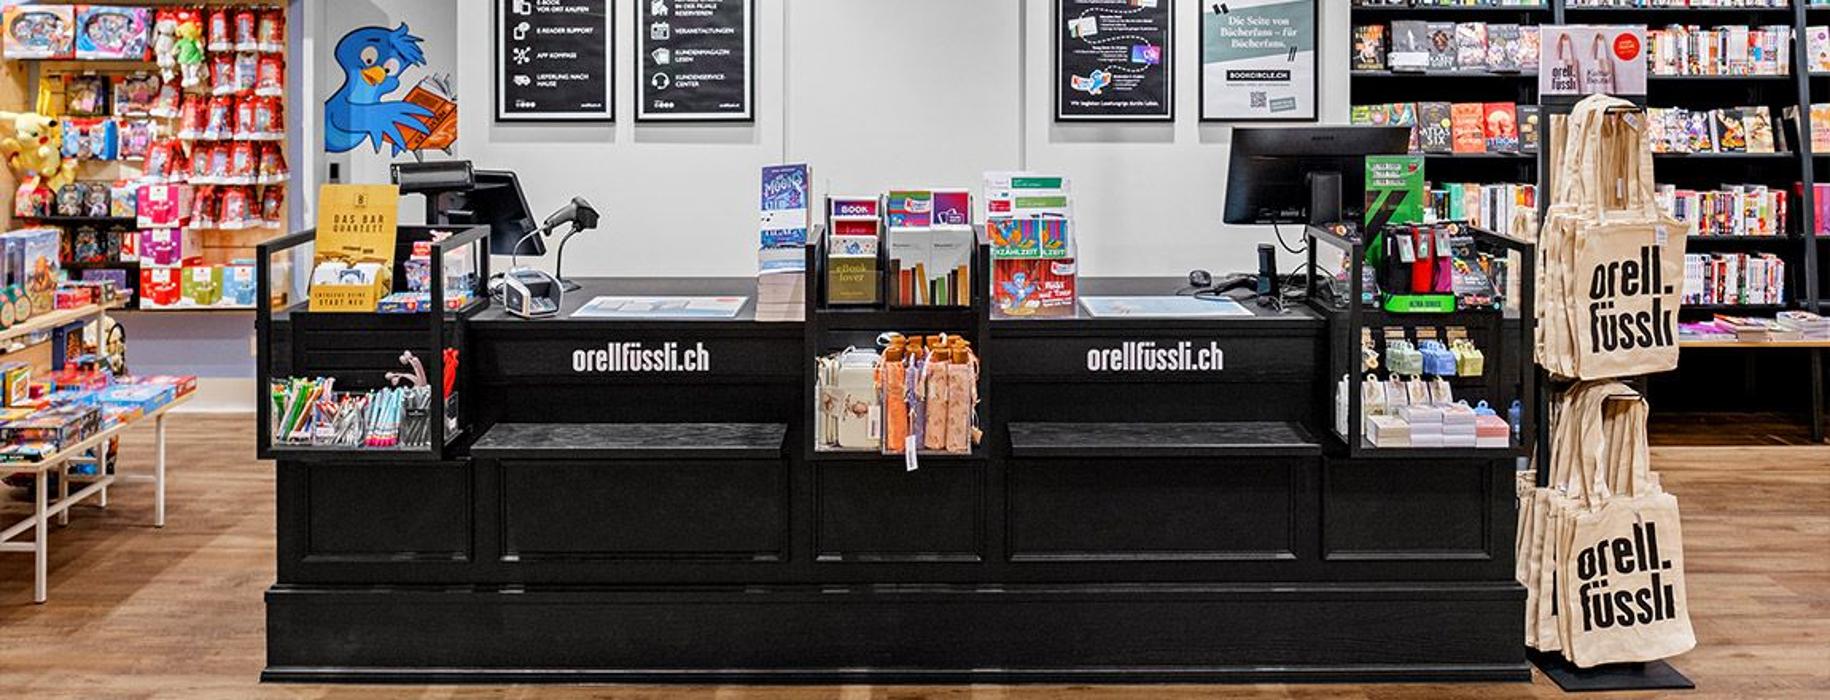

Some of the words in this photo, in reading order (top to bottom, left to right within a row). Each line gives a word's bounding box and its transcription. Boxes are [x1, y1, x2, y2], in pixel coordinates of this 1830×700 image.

[1228, 16, 1245, 25] Die
[1247, 16, 1269, 25] Seite
[1220, 28, 1272, 37] Bücherfans
[1282, 27, 1298, 37] für
[1231, 39, 1286, 48] Bücherfans.
[1427, 135, 1446, 145] SIX
[841, 205, 868, 213] BOOK
[333, 214, 355, 223] DAS
[362, 214, 384, 223] BAR
[333, 225, 384, 233] QUARTETT
[836, 262, 866, 272] eBook
[1589, 245, 1673, 299] orell.
[839, 272, 864, 282] lover
[1589, 297, 1673, 353] füssli
[572, 342, 709, 371] orellfüssli.ch
[1087, 341, 1223, 371] orellfüssli.ch
[1577, 522, 1672, 580] orell.
[1579, 572, 1675, 631] füssli
